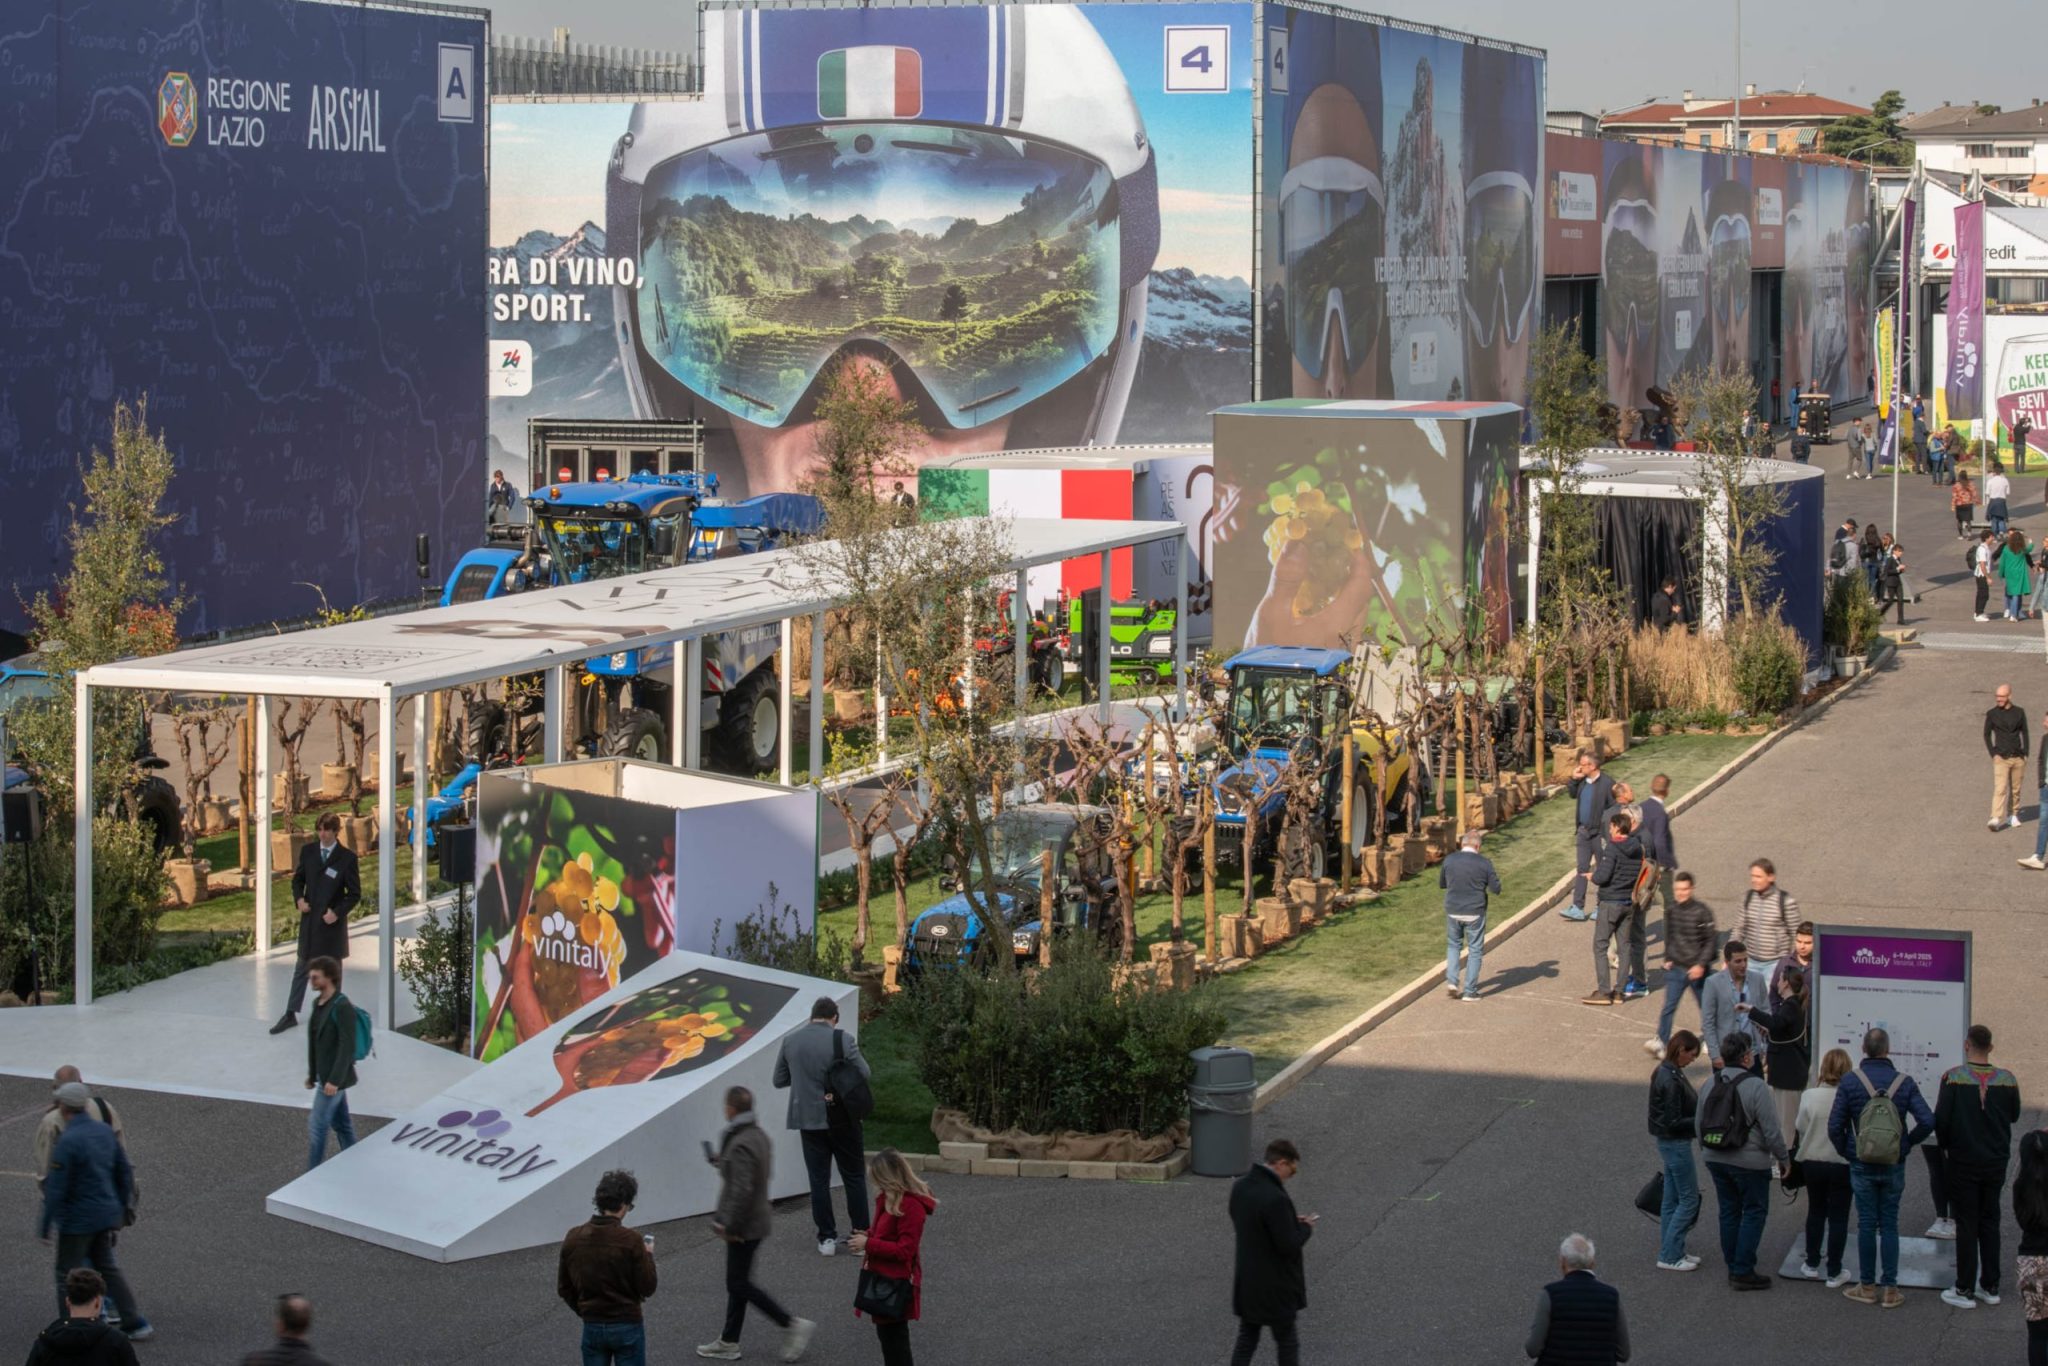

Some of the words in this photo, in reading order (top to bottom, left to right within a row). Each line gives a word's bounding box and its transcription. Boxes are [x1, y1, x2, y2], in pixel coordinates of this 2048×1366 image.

[1181, 46, 1212, 73] 4
[1274, 47, 1284, 75] 4
[207, 77, 291, 113] REGIONE
[446, 66, 467, 101] A
[207, 117, 266, 148] LAZIO
[530, 257, 557, 285] DI
[567, 257, 645, 289] VINO,
[493, 294, 592, 322] SPORT.
[2009, 372, 2046, 391] CALM
[2019, 392, 2045, 409] BEVI
[1161, 501, 1174, 518] AS
[741, 629, 758, 645] NEW
[532, 934, 612, 978] vinitaly
[1852, 953, 1891, 968] vinitaly
[392, 1122, 558, 1181] vinitaly
[1704, 1133, 1723, 1144] 46
